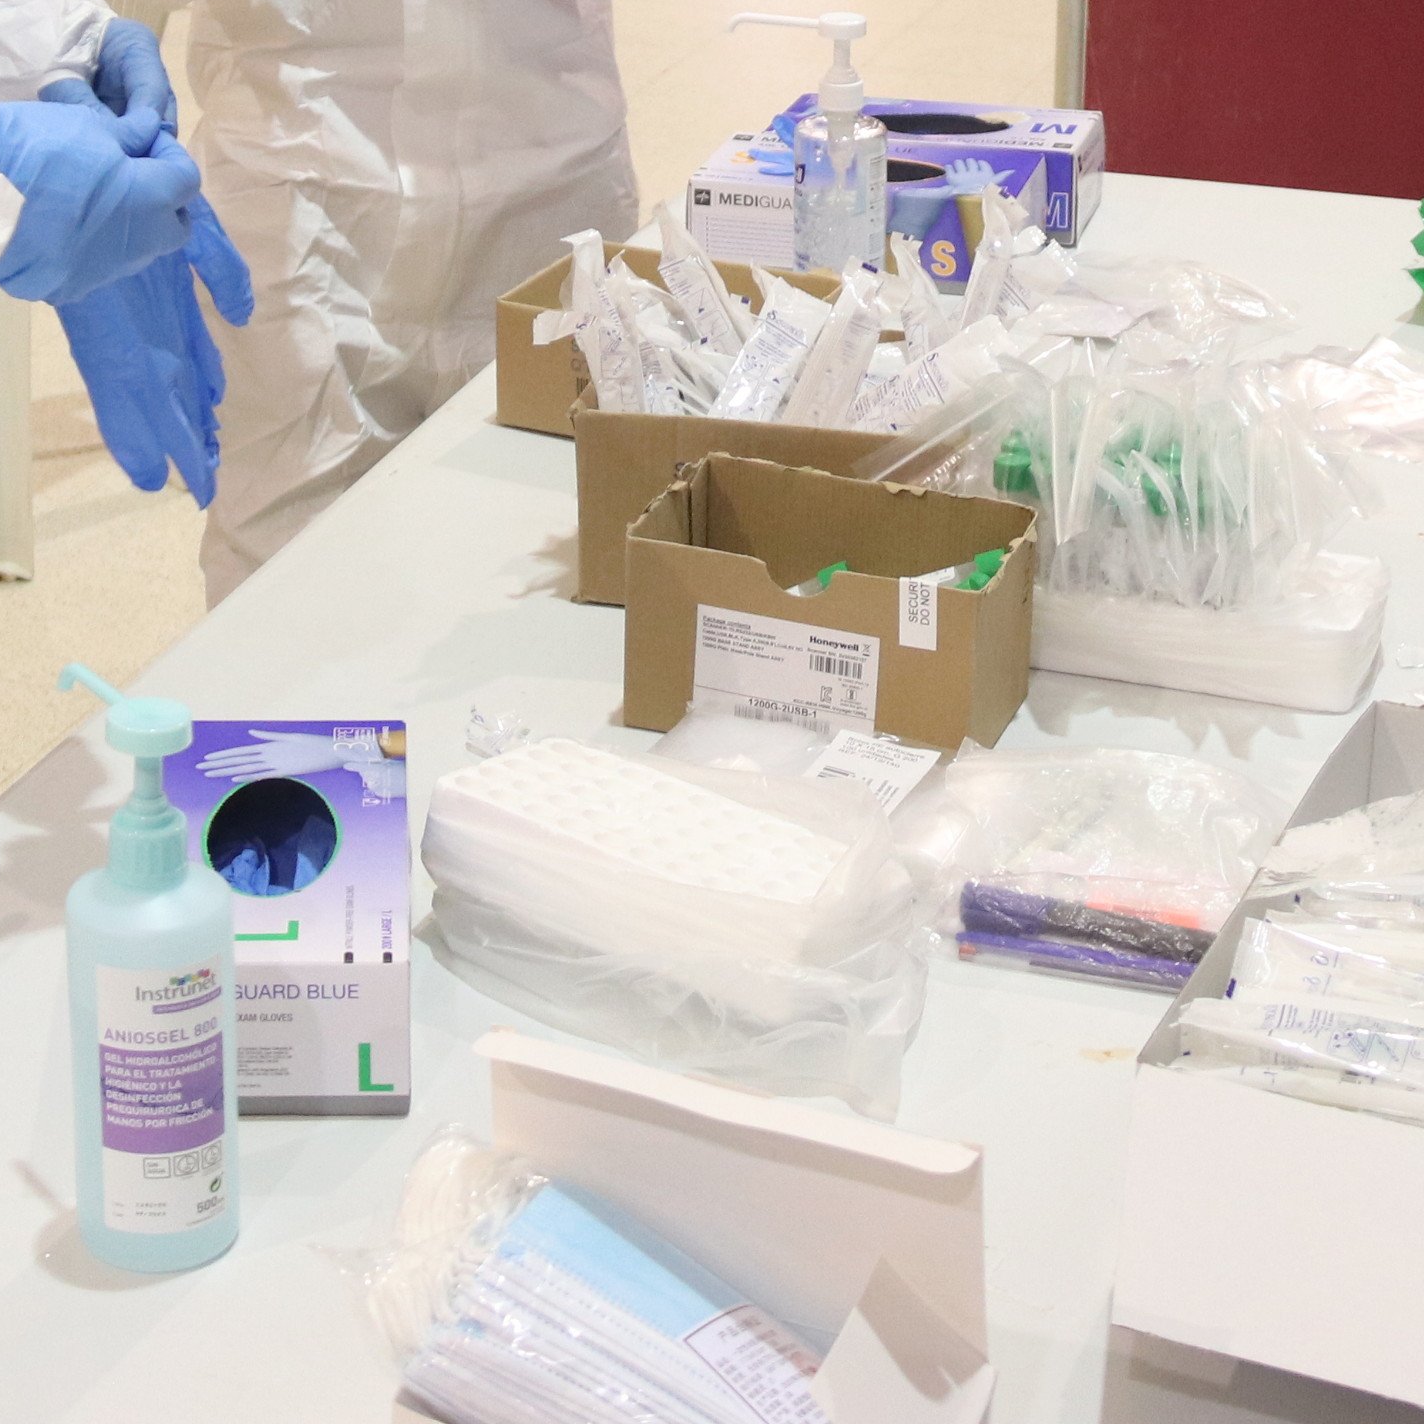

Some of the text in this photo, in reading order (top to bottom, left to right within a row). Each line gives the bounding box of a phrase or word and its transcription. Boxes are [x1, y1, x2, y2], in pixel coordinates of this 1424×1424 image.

[719, 192, 792, 210] MEDIGUA
[930, 239, 958, 277] S
[920, 582, 931, 626] DO NOT
[809, 635, 860, 653] Honeywell
[748, 698, 818, 719] 1200G-2USB-1
[135, 973, 216, 1001] Instrunet
[235, 984, 360, 1000] GUARD BLUE
[260, 1013, 294, 1023] GLOVES
[104, 1016, 218, 1045] ANIOSGEL 800
[104, 1052, 125, 1065] GEL
[104, 1055, 216, 1078] PARA EL TRATAMIENTO
[358, 1042, 395, 1092] L
[159, 1082, 167, 1090] Y
[168, 1079, 182, 1090] LA
[191, 1097, 204, 1110] DE
[107, 1113, 144, 1128] MANOS
[144, 1118, 168, 1128] POR
[196, 1196, 218, 1213] 500
